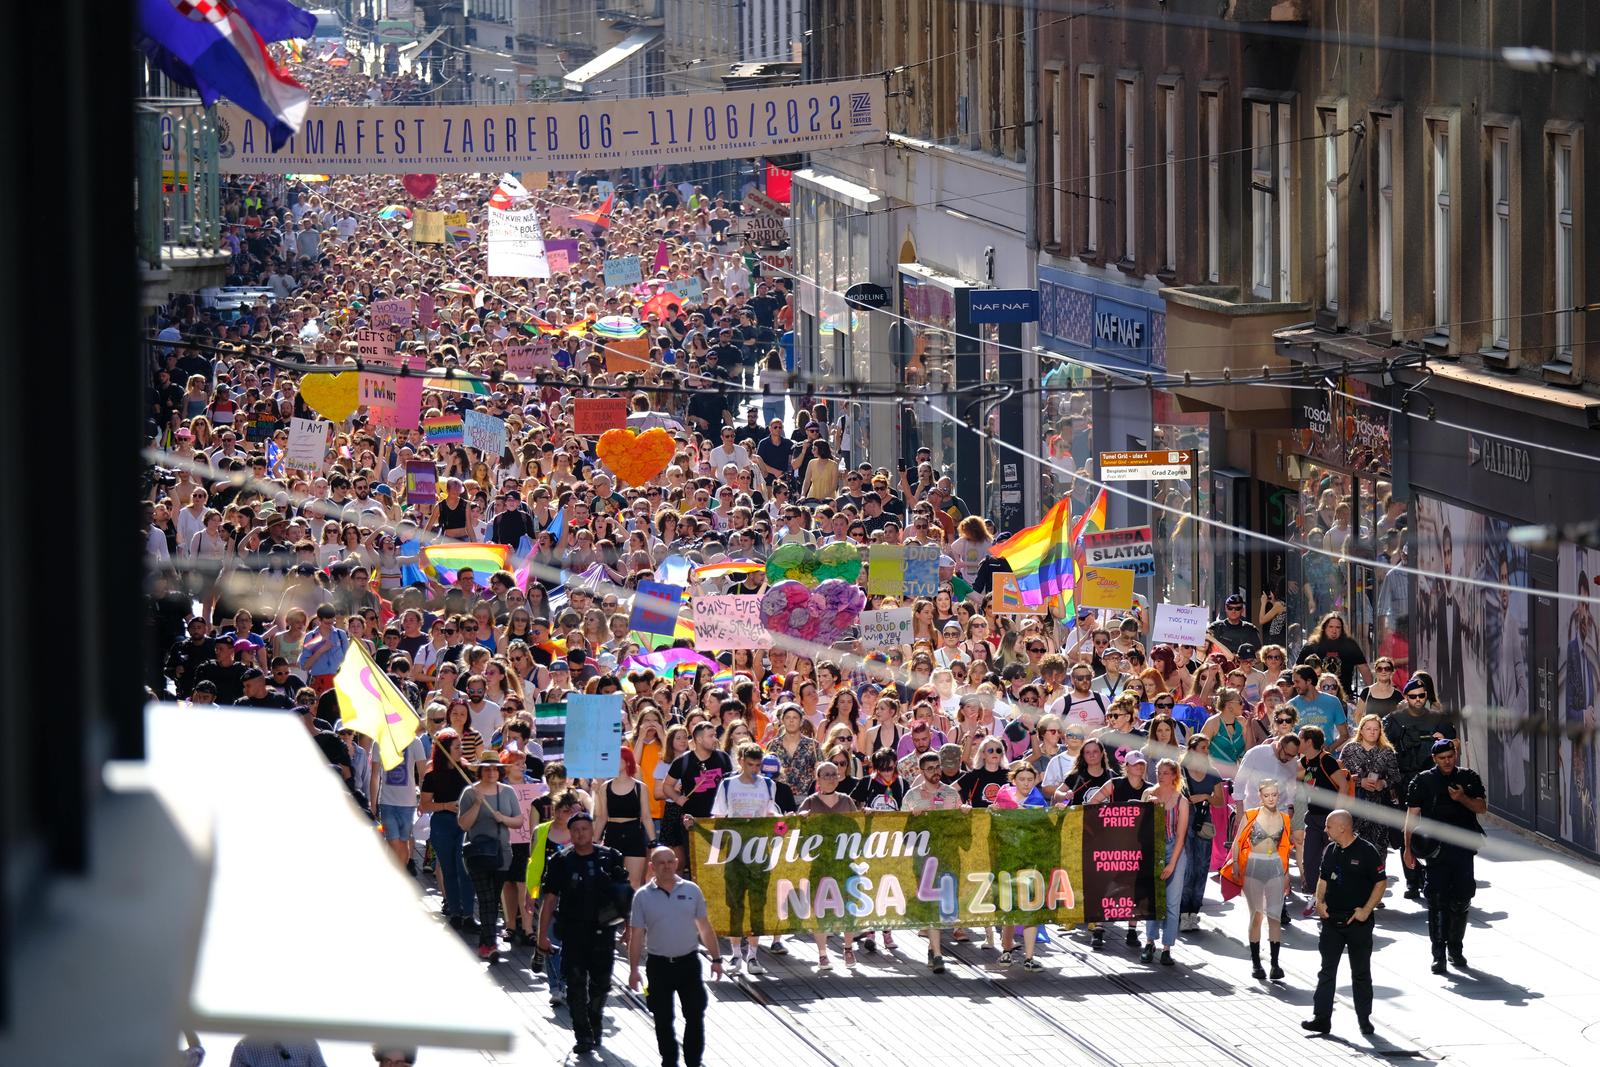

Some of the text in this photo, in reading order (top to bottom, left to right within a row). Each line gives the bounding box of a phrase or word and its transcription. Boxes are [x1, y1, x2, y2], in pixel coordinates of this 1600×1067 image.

[443, 116, 558, 154] ZAGREB
[747, 218, 784, 230] SALON
[848, 293, 885, 302] MODELINE
[972, 302, 1030, 311] NAF NAF
[1095, 311, 1143, 348] NAF NAF
[359, 331, 385, 342] LET'S
[360, 346, 378, 355] ONE
[1303, 405, 1332, 425] TOSCA
[306, 423, 322, 434] AM
[1309, 421, 1325, 434] BLU
[1482, 437, 1531, 482] GALILEO
[1151, 468, 1188, 478] Grad Zagreb
[1092, 543, 1153, 562] SLATKA
[875, 611, 889, 623] BE
[864, 619, 911, 634] PROUD OF
[864, 631, 902, 641] WHO YOU
[1098, 805, 1141, 819] ZAGREB
[1103, 817, 1136, 828] PRIDE
[704, 822, 931, 872] Dajte nam
[1093, 849, 1143, 862] POVORKA
[1096, 860, 1141, 872] PONOSA
[776, 856, 1076, 922] NAŠA 4 ZIDA
[1101, 897, 1137, 909] 04.06.
[1103, 907, 1136, 919] 2022.
